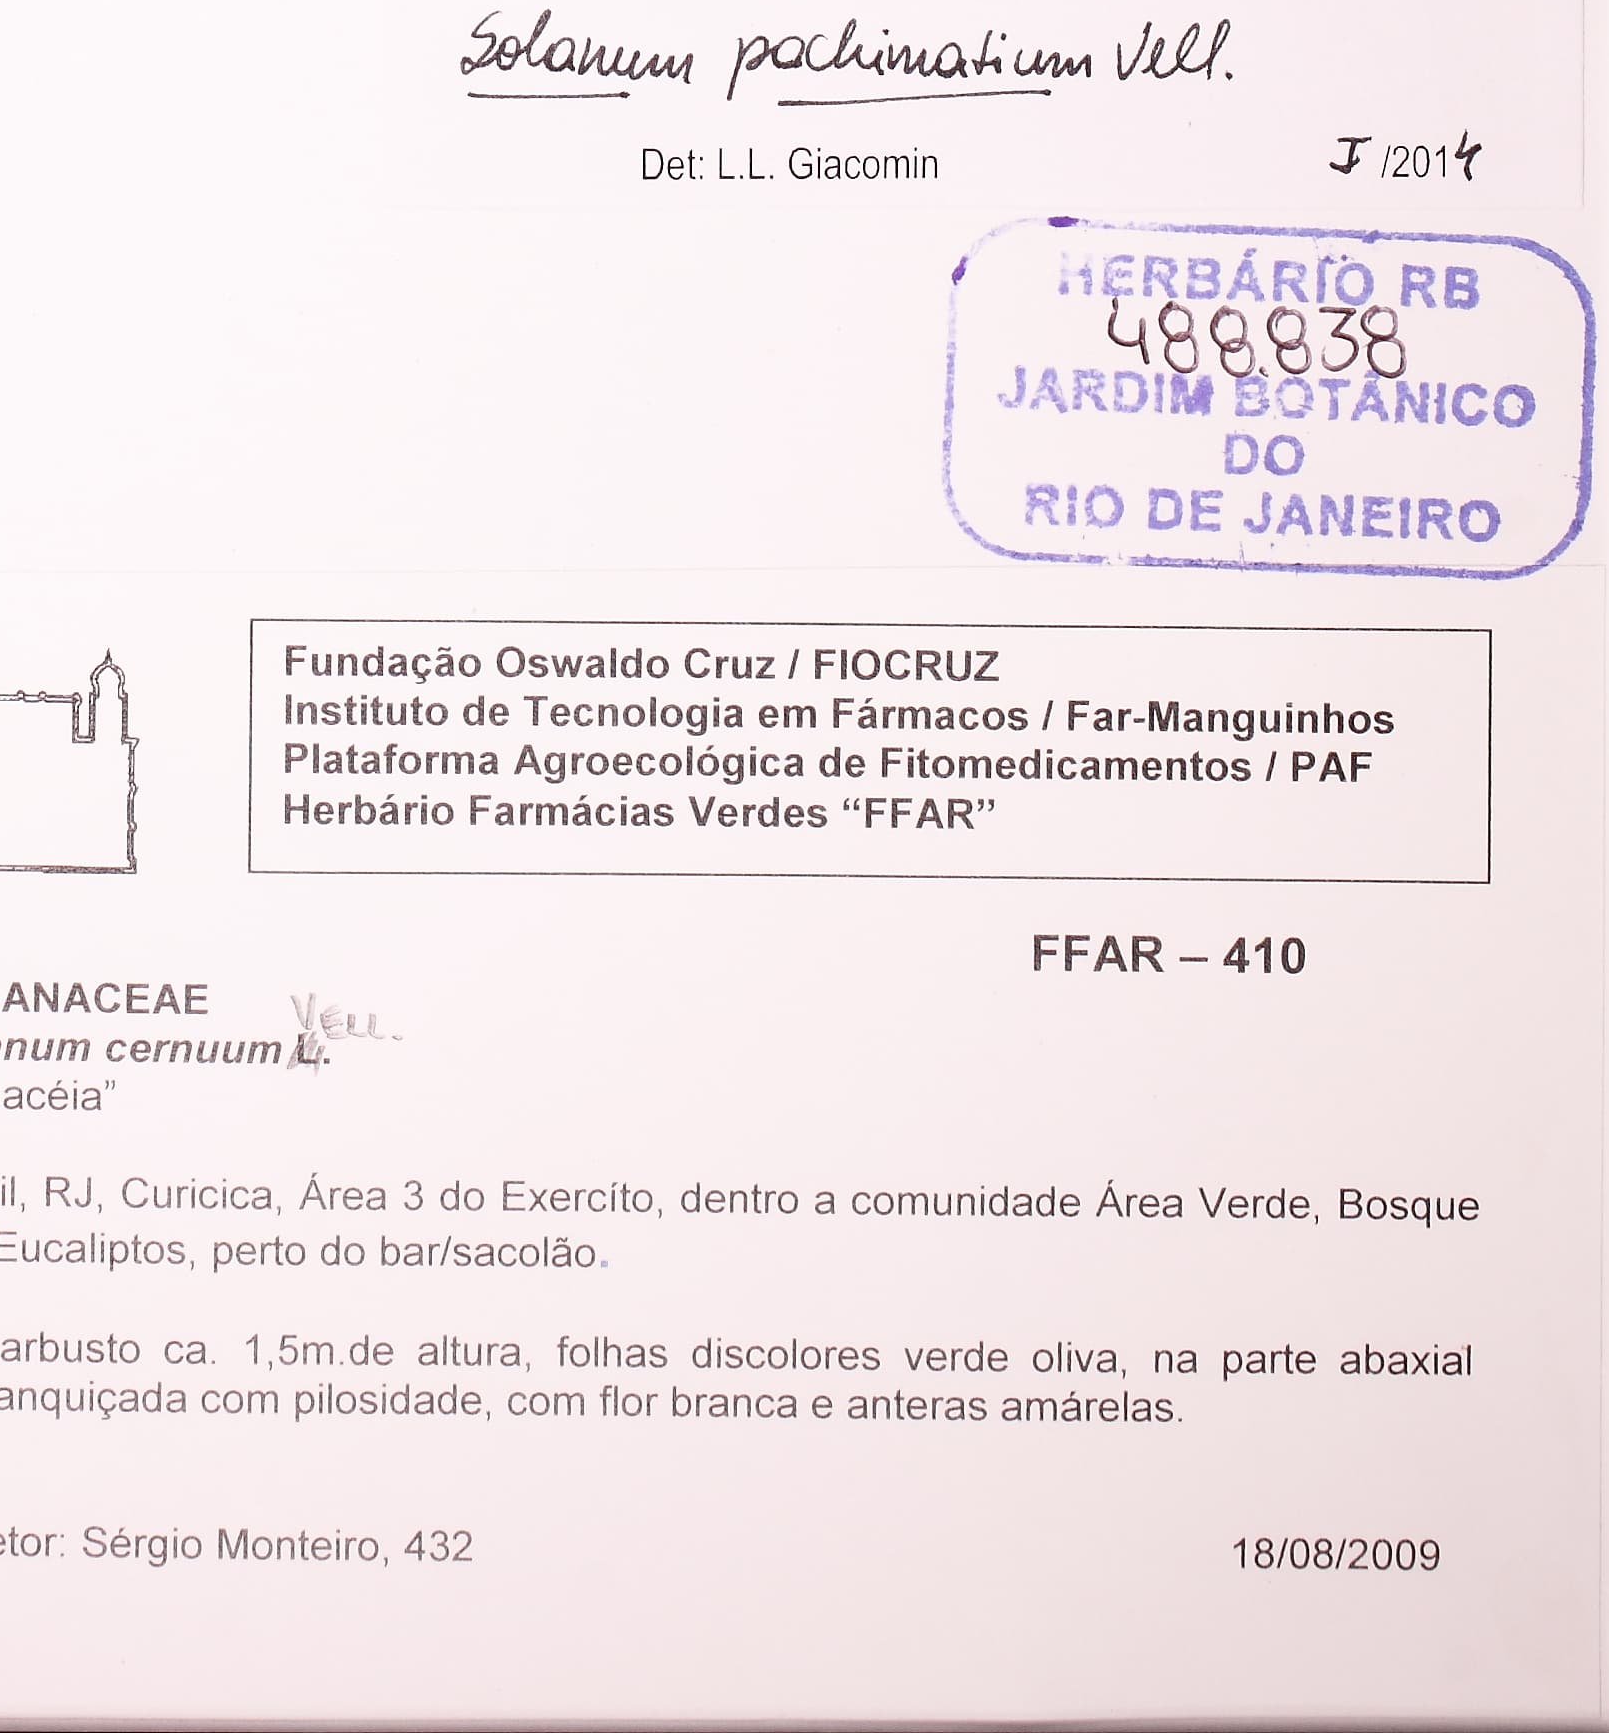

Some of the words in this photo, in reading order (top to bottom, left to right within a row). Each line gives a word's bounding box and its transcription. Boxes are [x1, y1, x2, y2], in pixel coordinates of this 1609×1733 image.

[460, 7, 693, 84] Solanum
[1115, 18, 1236, 83] Vell.
[641, 146, 705, 182] Det:
[717, 146, 775, 181] L.L.
[787, 145, 939, 182] Giacomin
[1057, 247, 1375, 307] HERBÁRIO
[1399, 263, 1481, 310] RB
[996, 365, 1215, 417] JARDIM
[1233, 369, 1538, 429] BOTÂNICO
[1222, 433, 1306, 477] DO
[1023, 483, 1126, 529] RIO
[1147, 486, 1225, 532] DE
[1242, 490, 1503, 544] JANEIRO
[284, 643, 483, 686] Fundação
[495, 644, 671, 681] Oswaldo
[683, 646, 777, 681] Cruz
[786, 647, 801, 681] /
[813, 647, 1001, 683] FIOCRUZ
[284, 692, 450, 728] Instituto
[461, 693, 511, 728] de
[522, 694, 745, 738] Tecnologia
[757, 703, 818, 730] em
[831, 696, 1030, 733] Fármacos
[1040, 698, 1055, 733] /
[1066, 698, 1396, 743] Far-Manguinhos
[283, 741, 501, 777] Plataforma
[512, 742, 806, 787] Agroecológica
[817, 745, 867, 780] de
[880, 745, 1253, 783] Fitomedicamentos
[1264, 749, 1279, 783] /
[1290, 749, 1374, 784] PAF
[282, 792, 456, 827] Herbário
[468, 793, 676, 829] Farmácias
[687, 794, 829, 830] Verdes
[841, 796, 996, 831] “FFAR”
[1032, 933, 1166, 974] FFAR
[1221, 935, 1307, 976] 410
[104, 1032, 284, 1066] cernuum
[44, 1174, 104, 1215] RJ,
[120, 1175, 283, 1218] Curicica,
[297, 1171, 388, 1212] Área
[402, 1178, 425, 1212] 3
[438, 1178, 486, 1213] do
[501, 1179, 664, 1220] Exercíto,
[679, 1180, 800, 1216] dentro
[813, 1189, 837, 1216] a
[850, 1183, 1082, 1219] comunidade
[1094, 1177, 1184, 1220] Área
[1197, 1185, 1320, 1227] Verde,
[1338, 1186, 1481, 1231] Bosque
[212, 1234, 307, 1275] perto
[319, 1233, 367, 1268] do
[379, 1233, 610, 1270] bar/sacolão.
[163, 1339, 217, 1366] ca.
[416, 1333, 532, 1374] altura,
[555, 1334, 669, 1370] folhas
[690, 1336, 882, 1372] discolores
[903, 1339, 1010, 1374] verde
[1031, 1339, 1128, 1381] oliva,
[1153, 1348, 1199, 1375] na
[1221, 1342, 1318, 1384] parte
[1338, 1341, 1473, 1378] abaxial
[200, 1388, 280, 1415] com
[293, 1381, 492, 1424] pilosidade,
[506, 1390, 586, 1418] com
[598, 1383, 660, 1418] flor
[670, 1384, 799, 1420] branca
[810, 1393, 834, 1421] e
[846, 1387, 989, 1423] anteras
[1000, 1388, 1184, 1424] amárelas.
[81, 1524, 204, 1569] Sérgio
[216, 1527, 390, 1569] Monteiro,
[402, 1528, 474, 1564] 432
[1232, 1536, 1441, 1573] 18/08/2009
